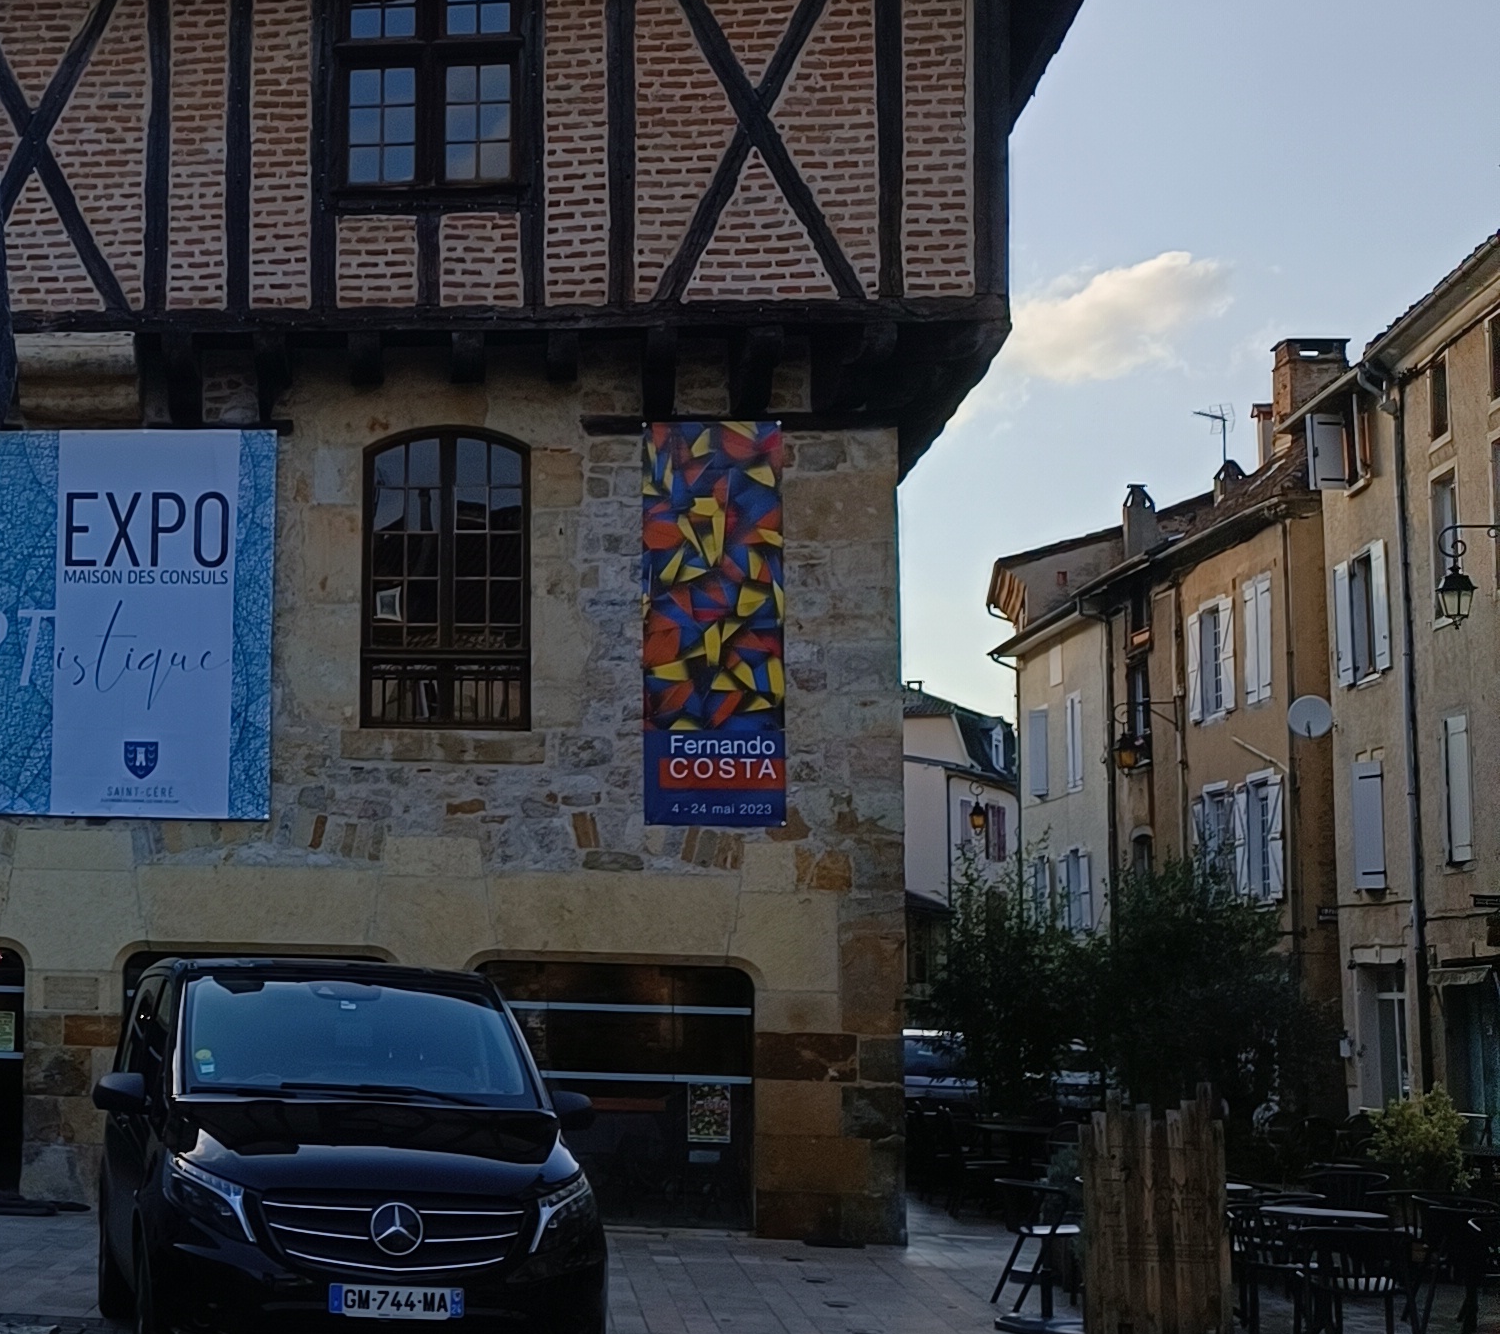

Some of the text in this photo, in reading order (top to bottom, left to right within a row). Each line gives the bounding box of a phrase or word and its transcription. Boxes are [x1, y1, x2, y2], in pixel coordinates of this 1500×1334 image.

[64, 490, 230, 568] EXPO
[63, 569, 229, 586] MAISON DES CONSULS
[670, 735, 776, 755] Fernando
[669, 757, 777, 780] COSTA
[671, 803, 680, 814] 4
[691, 803, 707, 814] 24
[711, 803, 735, 815] mai
[739, 804, 772, 815] 2023
[343, 1288, 449, 1313] GM-744-MA
